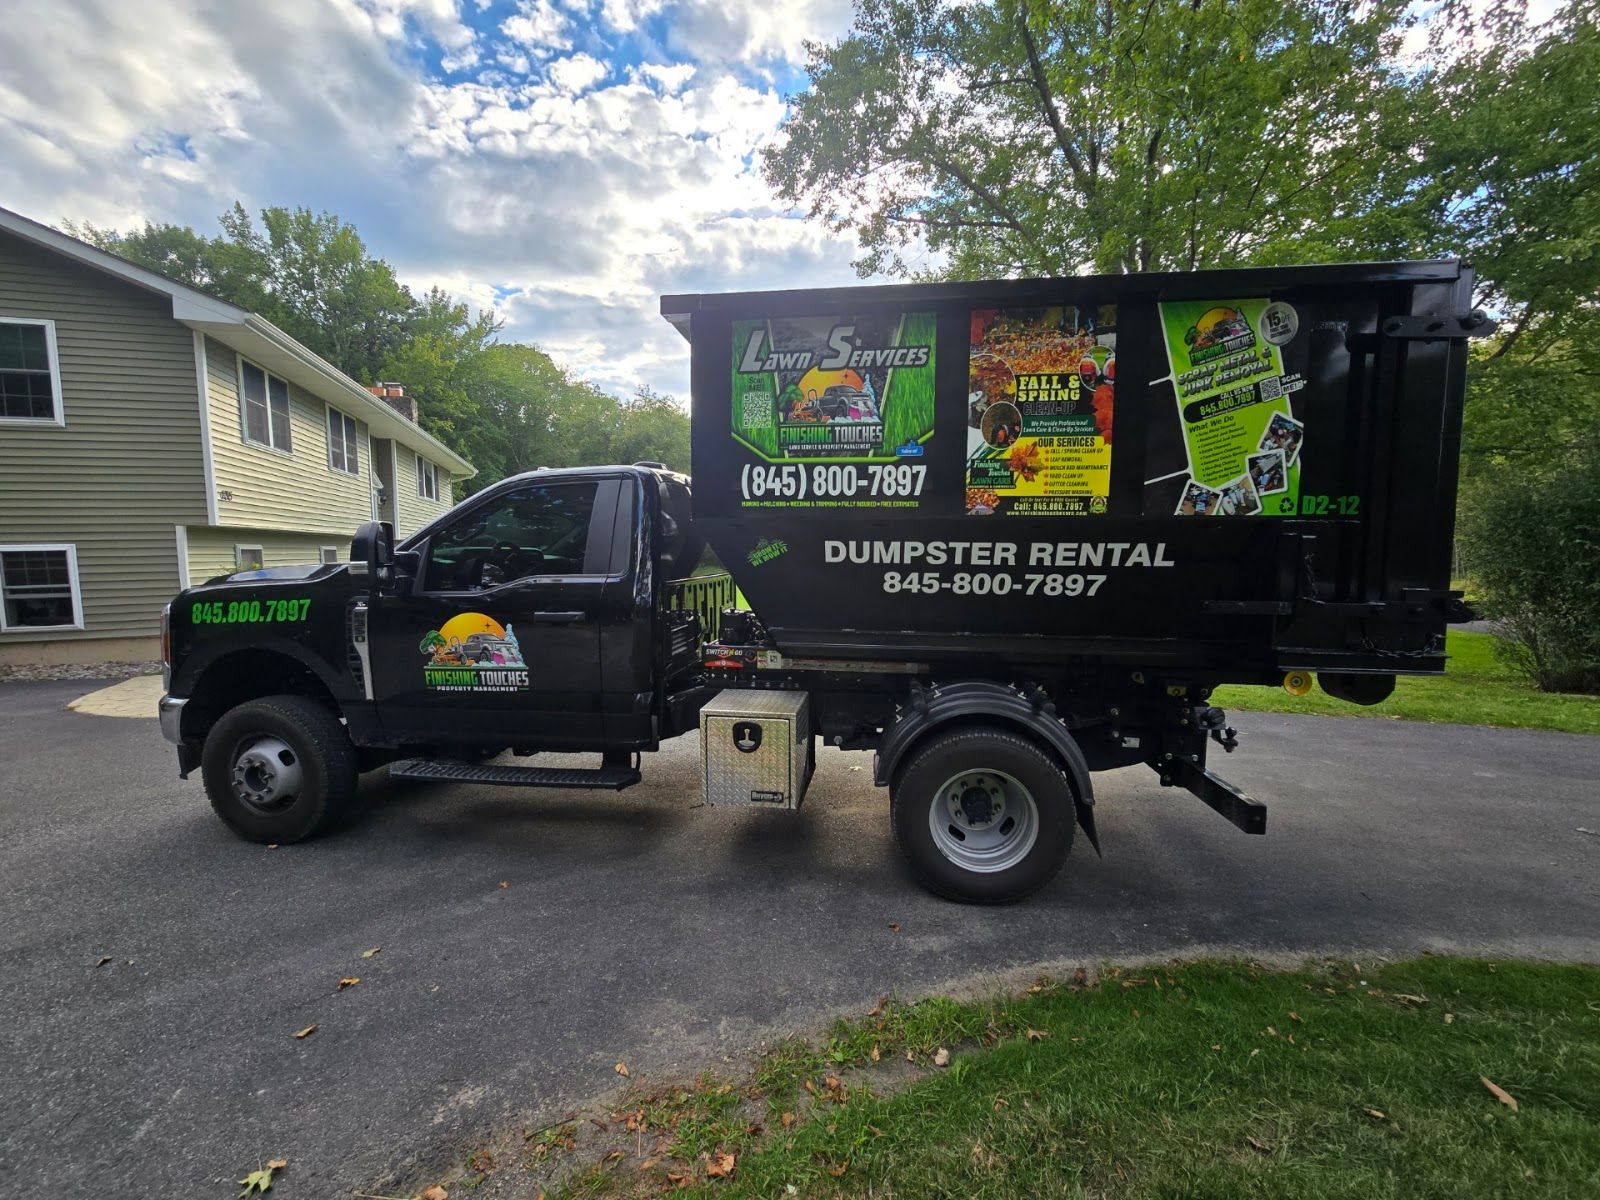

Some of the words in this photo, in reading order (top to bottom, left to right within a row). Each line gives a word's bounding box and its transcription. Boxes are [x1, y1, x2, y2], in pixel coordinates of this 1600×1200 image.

[1224, 334, 1255, 351] TOUCHES
[1178, 363, 1218, 384] SCRAP
[1219, 350, 1259, 372] METAL
[1019, 375, 1061, 390] FALL
[1068, 374, 1080, 389] &
[1182, 376, 1213, 397] JUNK
[1216, 360, 1273, 386] REMOVAL
[1281, 373, 1301, 384] SCAN
[1018, 389, 1080, 402] SPRING
[1220, 392, 1234, 400] CALL
[1241, 385, 1254, 393] NOW
[1023, 401, 1076, 416] CLEAN-UP
[1200, 391, 1255, 416] 845.800.7897
[1189, 423, 1208, 433] What
[1210, 418, 1222, 427] We
[780, 426, 832, 444] FINISHING
[834, 426, 883, 443] TOUCHES
[1038, 437, 1054, 447] OUR
[1056, 437, 1095, 447] SERVICES
[973, 460, 1000, 469] Finishing
[988, 468, 1010, 476] Touches
[741, 463, 808, 500] (845)
[812, 464, 927, 497] 800-7897
[1014, 502, 1031, 510] Call:
[1033, 502, 1083, 511] 845.800.7897
[1301, 495, 1360, 515] D2-12
[751, 558, 763, 567] WE
[762, 550, 780, 562] MOW
[780, 546, 788, 554] IT
[824, 540, 1017, 566] DUMPSTER
[1028, 542, 1175, 568] RENTAL
[883, 572, 1107, 597] 845-800-7897
[192, 598, 311, 624] 845.800.7897
[425, 671, 478, 686] FINISHING
[479, 671, 529, 686] TOUCHES
